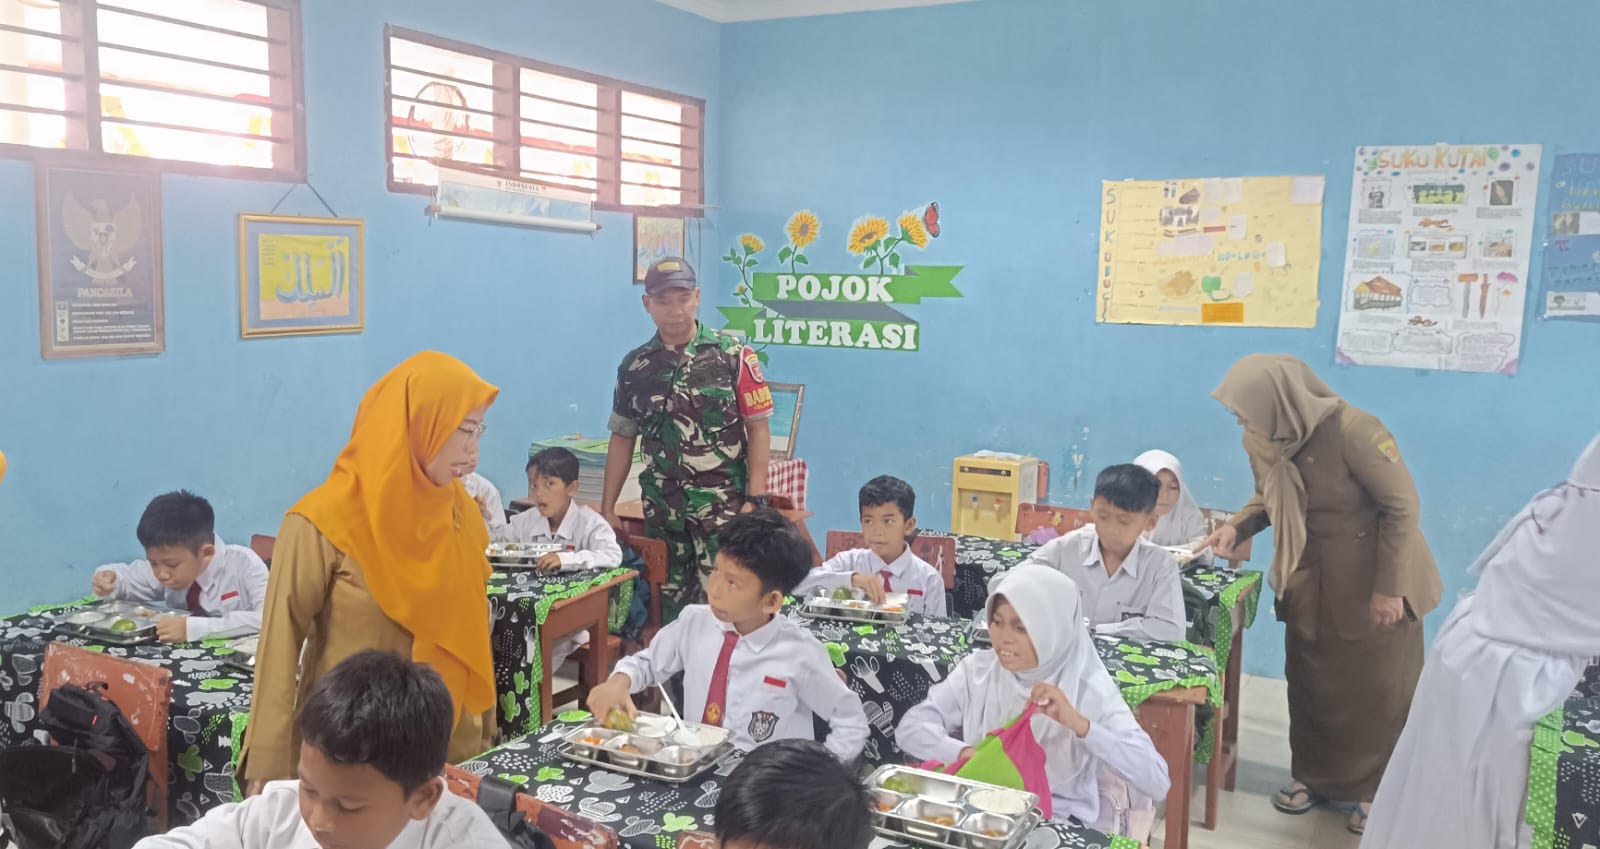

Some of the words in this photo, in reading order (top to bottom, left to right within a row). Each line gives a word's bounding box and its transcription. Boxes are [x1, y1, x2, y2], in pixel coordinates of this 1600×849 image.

[1377, 148, 1430, 170] SUKU
[777, 275, 893, 302] POJOK
[753, 319, 917, 349] LITERASI
